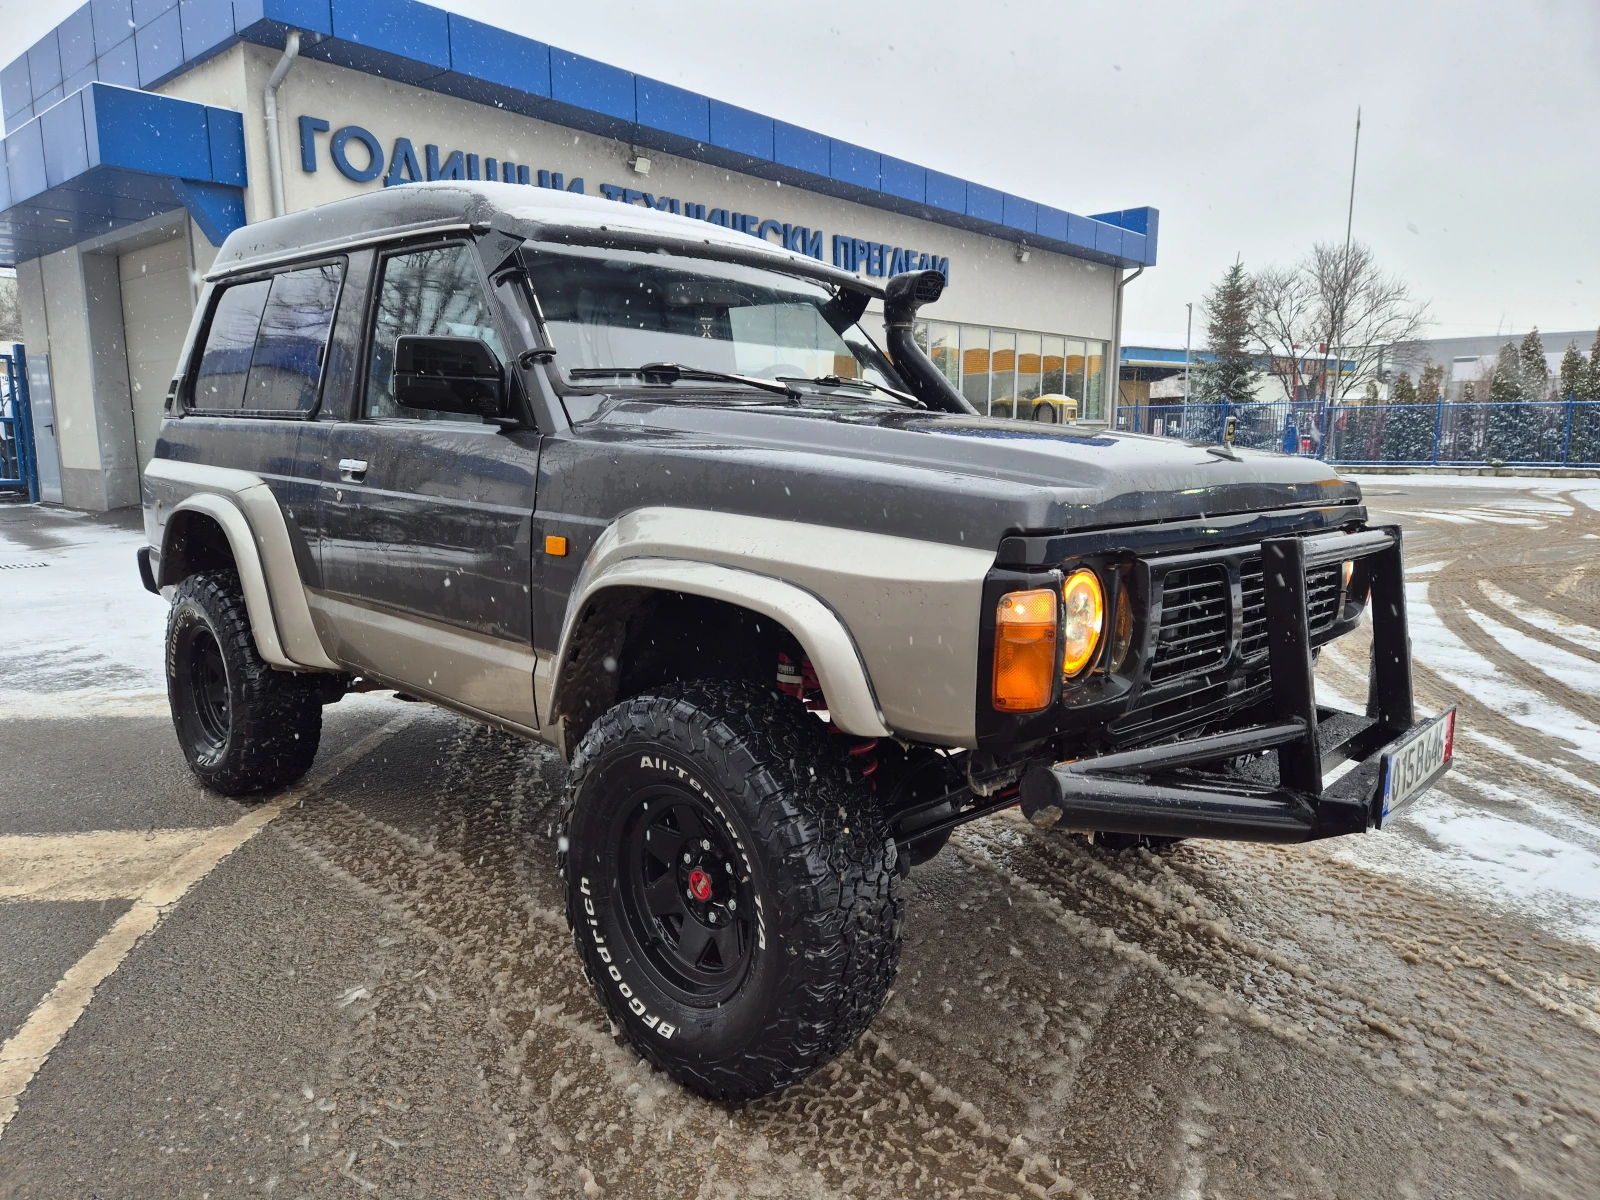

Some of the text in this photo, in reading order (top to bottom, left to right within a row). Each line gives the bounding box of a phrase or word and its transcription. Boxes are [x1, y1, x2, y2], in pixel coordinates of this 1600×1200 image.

[640, 756, 766, 951] All-Terrain T/A
[580, 877, 676, 1040] BFGoodrich
